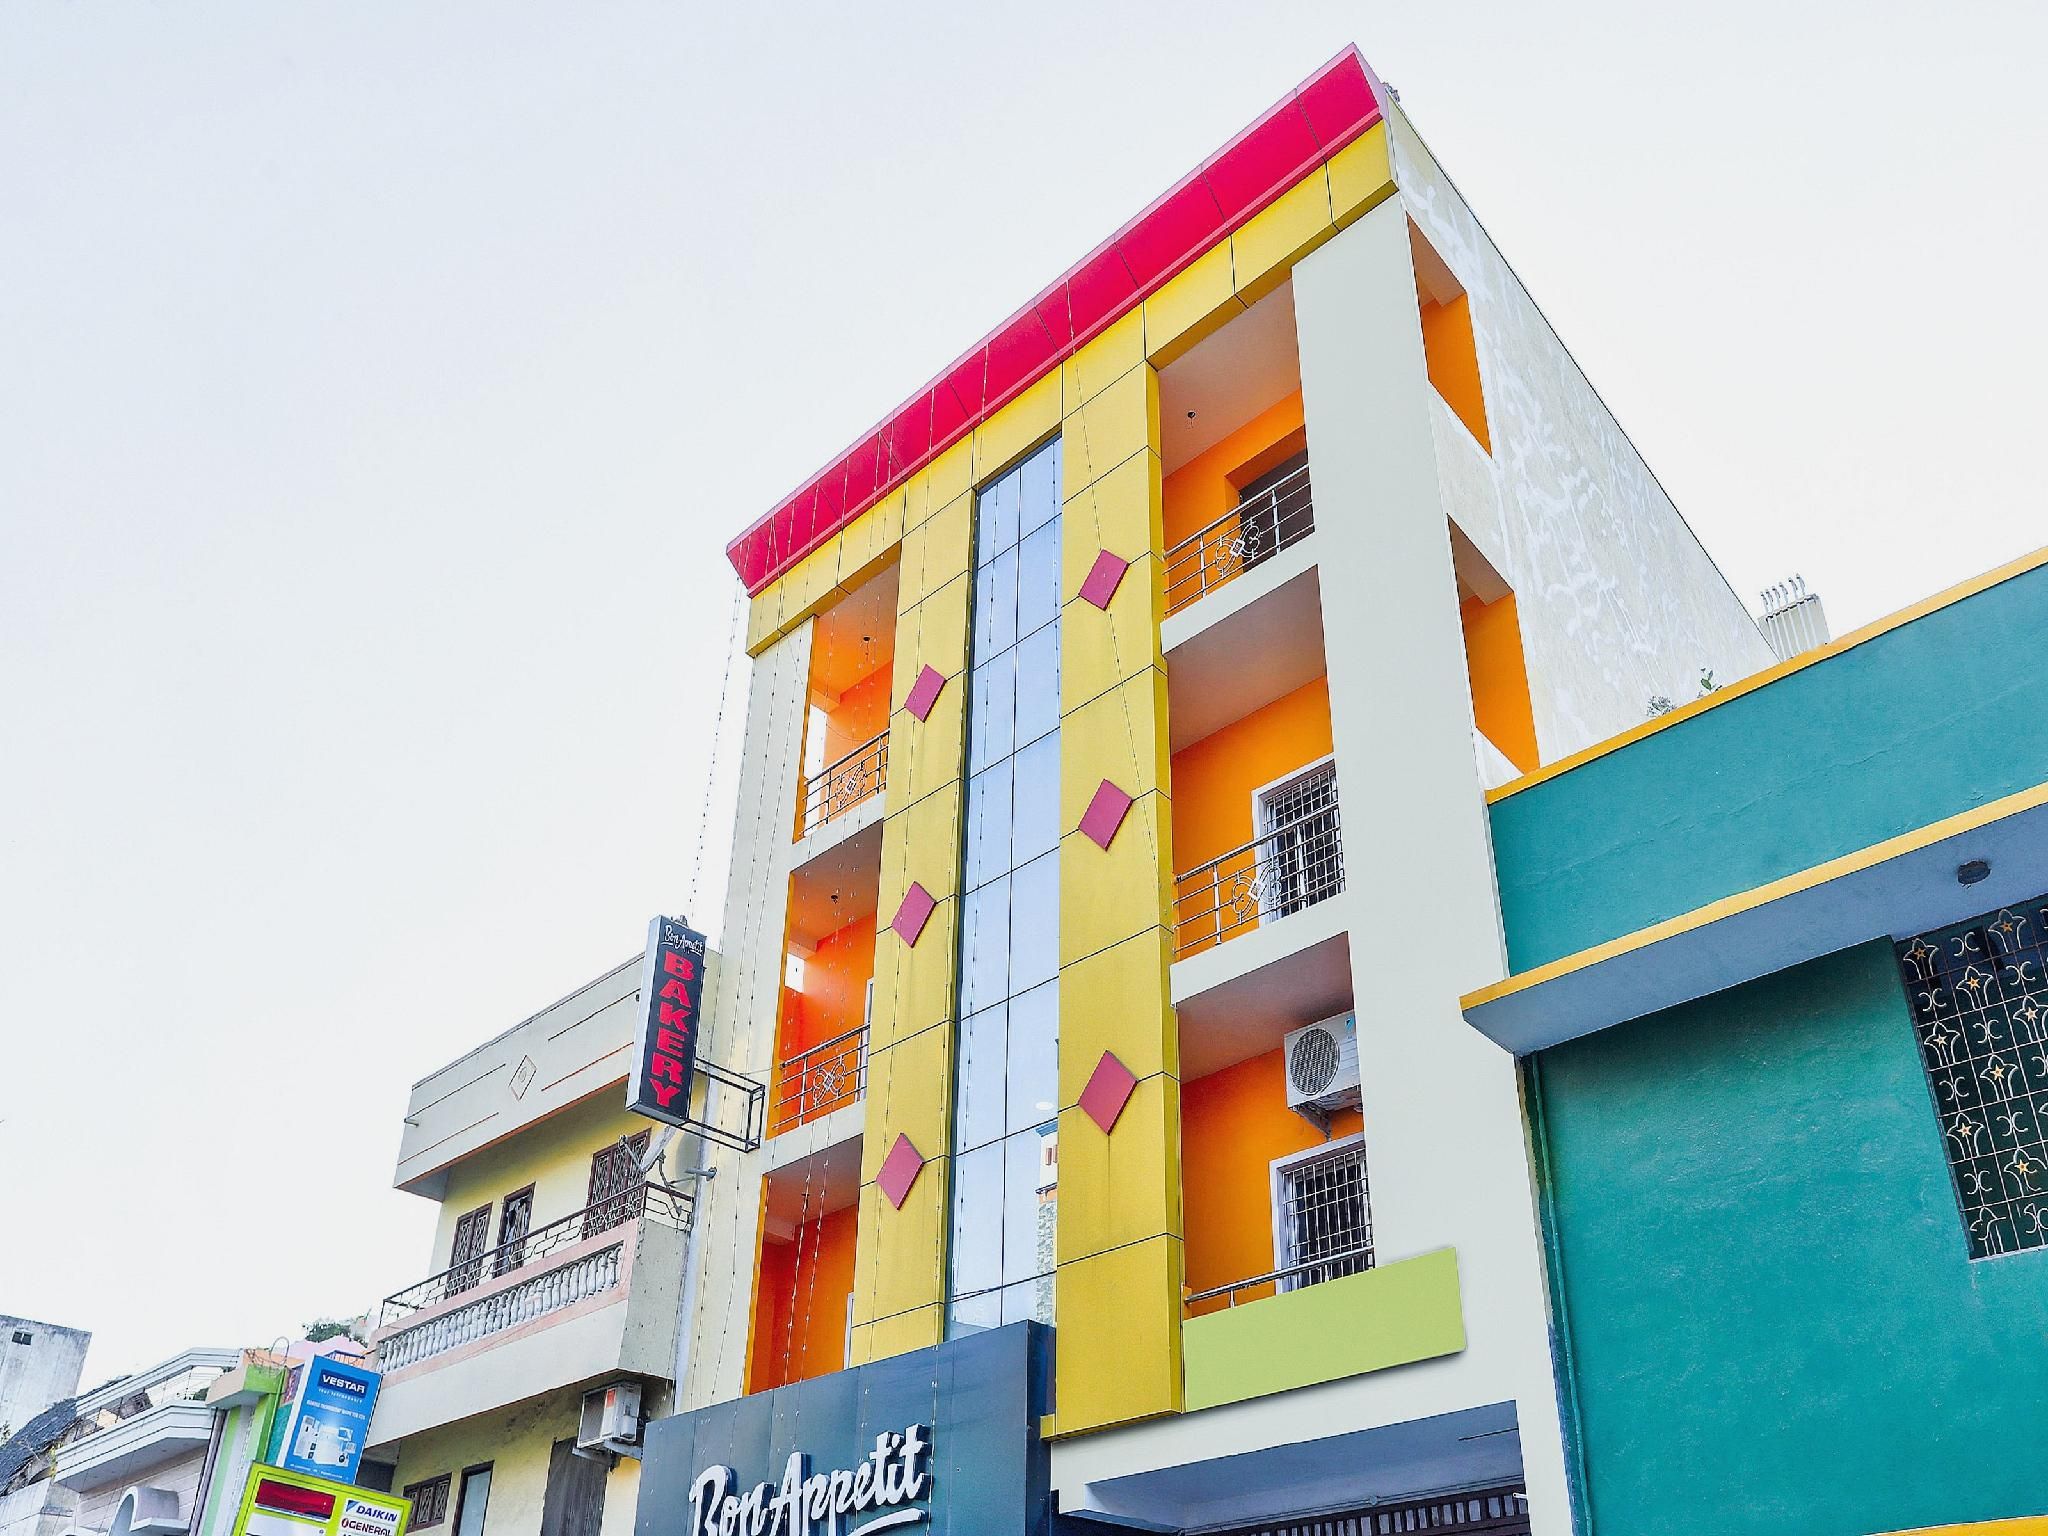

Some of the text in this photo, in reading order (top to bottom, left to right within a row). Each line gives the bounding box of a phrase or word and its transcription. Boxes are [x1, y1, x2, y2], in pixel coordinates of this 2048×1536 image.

[664, 924, 679, 944] Bon
[650, 951, 695, 1107] BAKERY
[322, 1374, 366, 1394] VESTAR
[689, 1423, 929, 1536] Bon Appetit
[355, 1504, 398, 1522] DAIKIN
